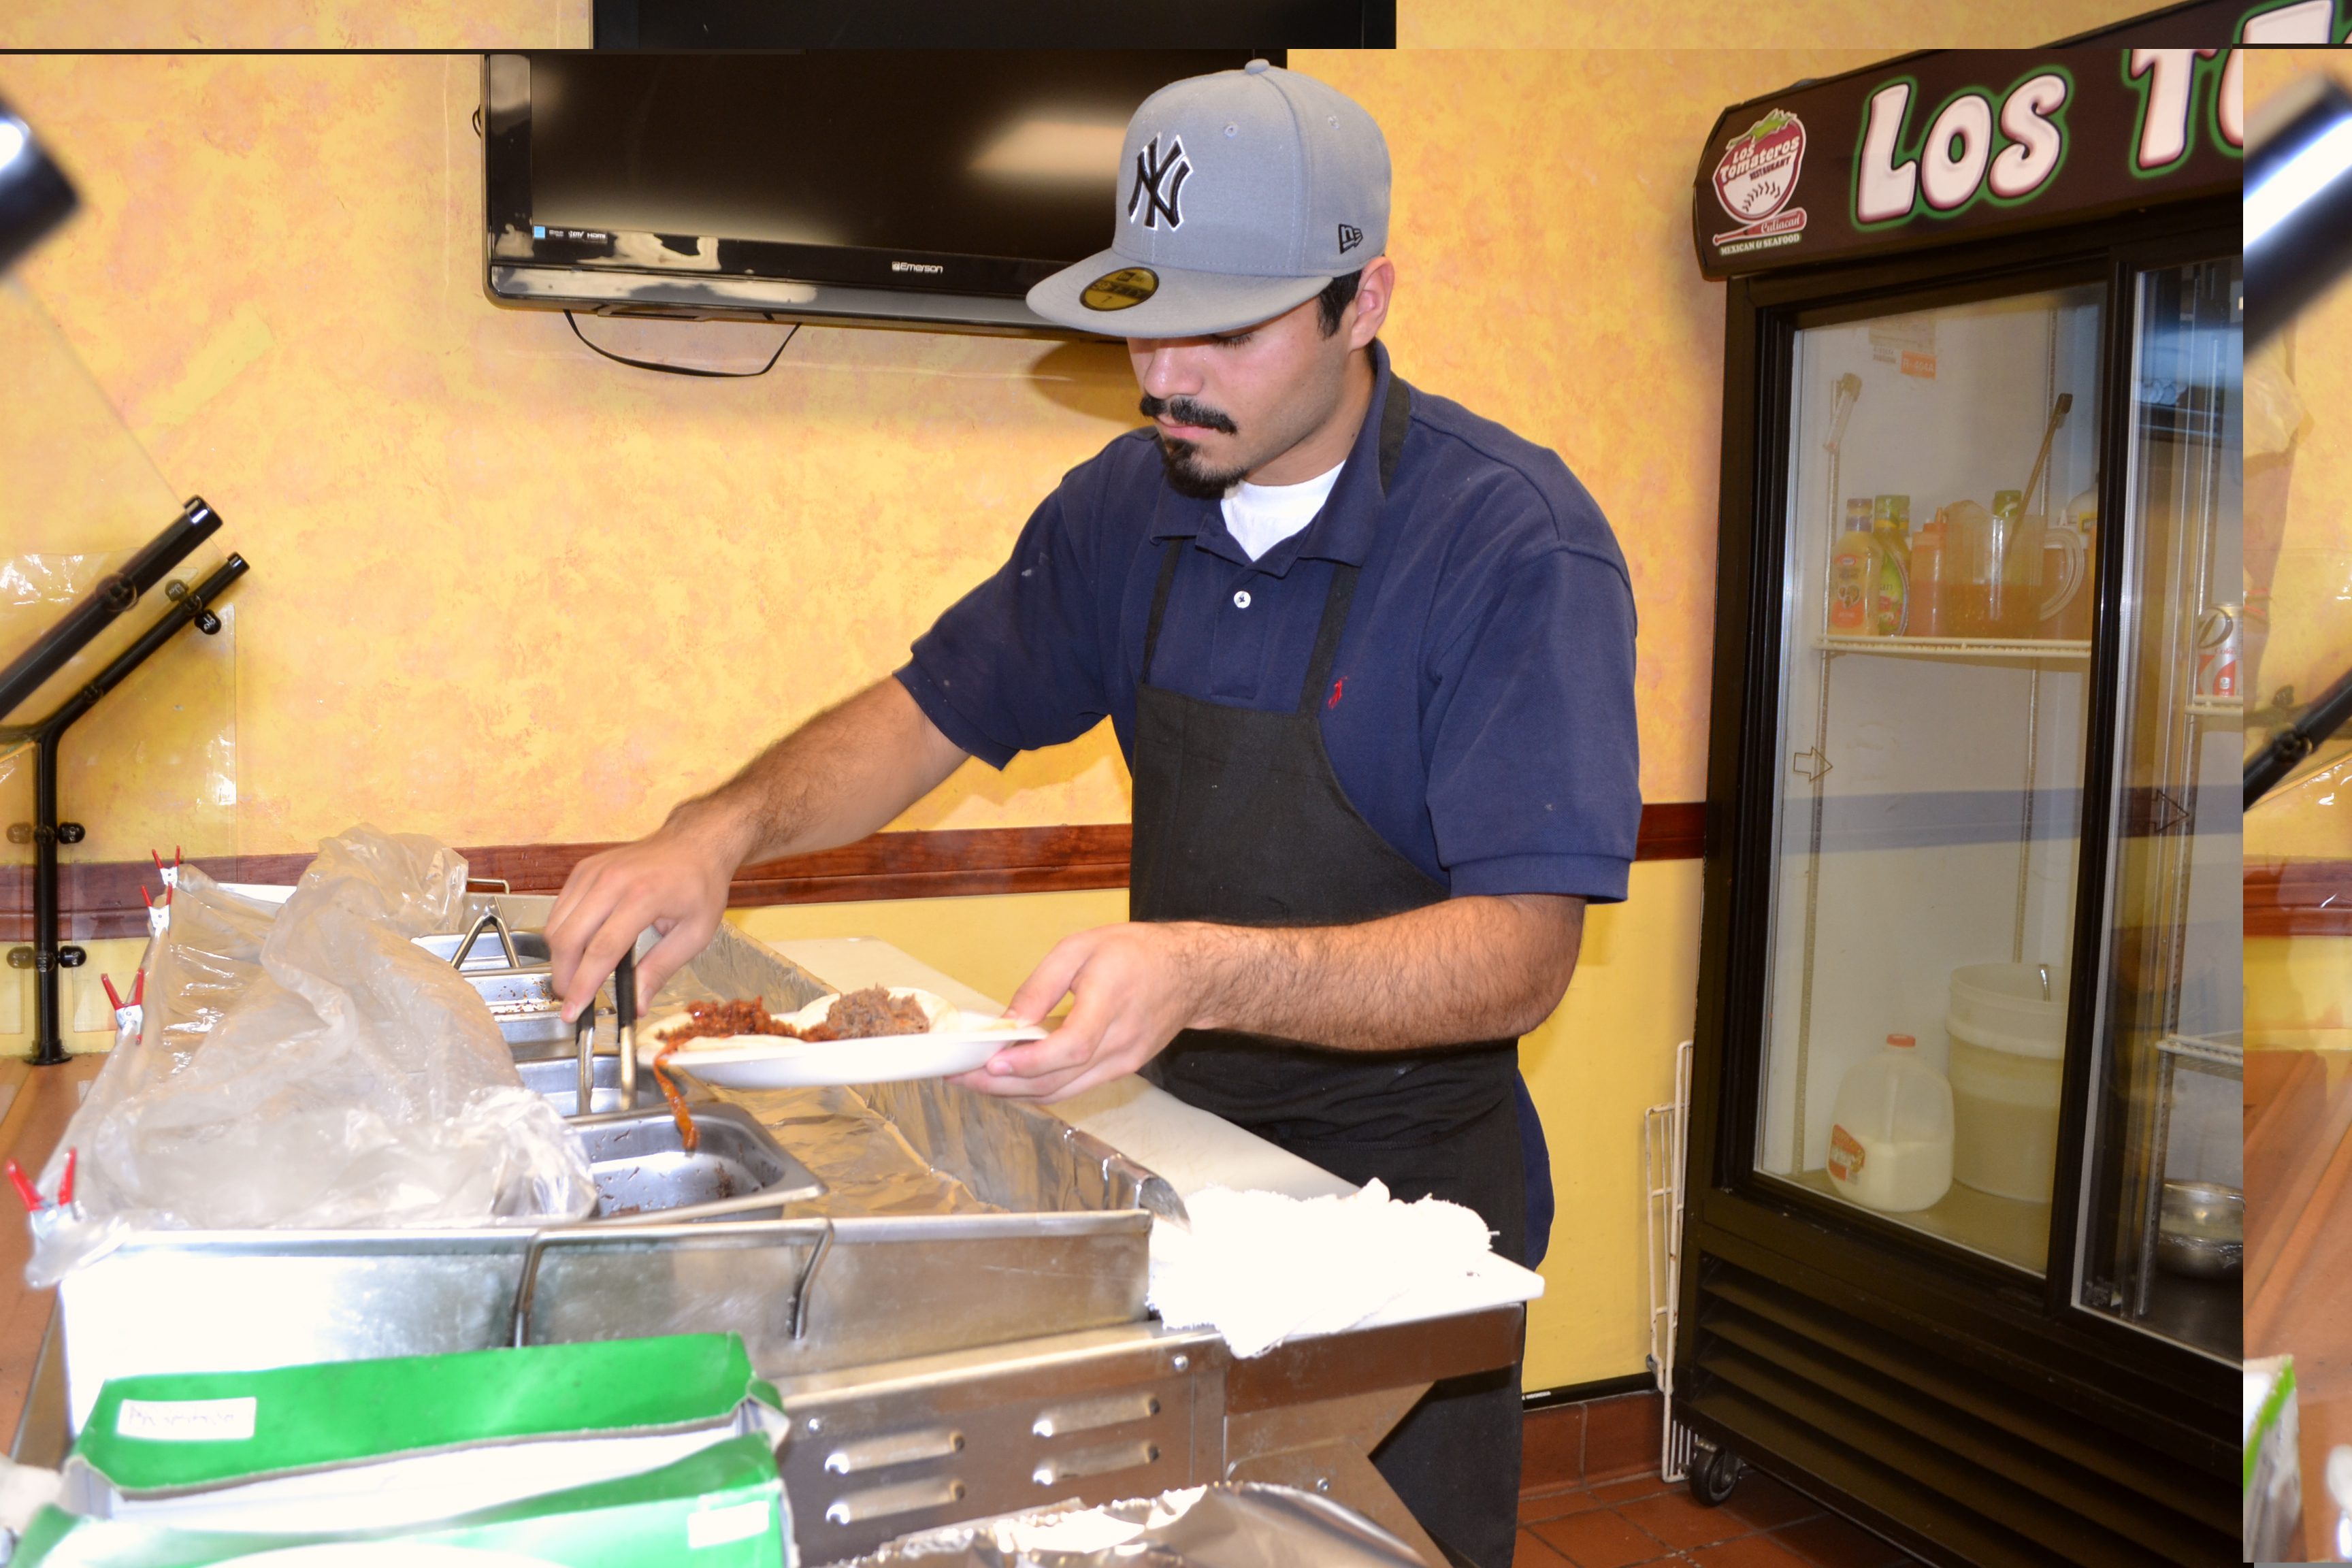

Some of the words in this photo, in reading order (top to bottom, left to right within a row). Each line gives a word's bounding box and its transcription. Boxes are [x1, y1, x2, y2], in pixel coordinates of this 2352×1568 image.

[1720, 137, 1800, 185] Tomateros
[1749, 156, 1791, 181] RESTAURANT
[1128, 131, 1193, 231] NY
[1721, 242, 1754, 255] MEXICAN
[1763, 233, 1800, 246] SEAFOOD
[900, 262, 943, 274] Emerson
